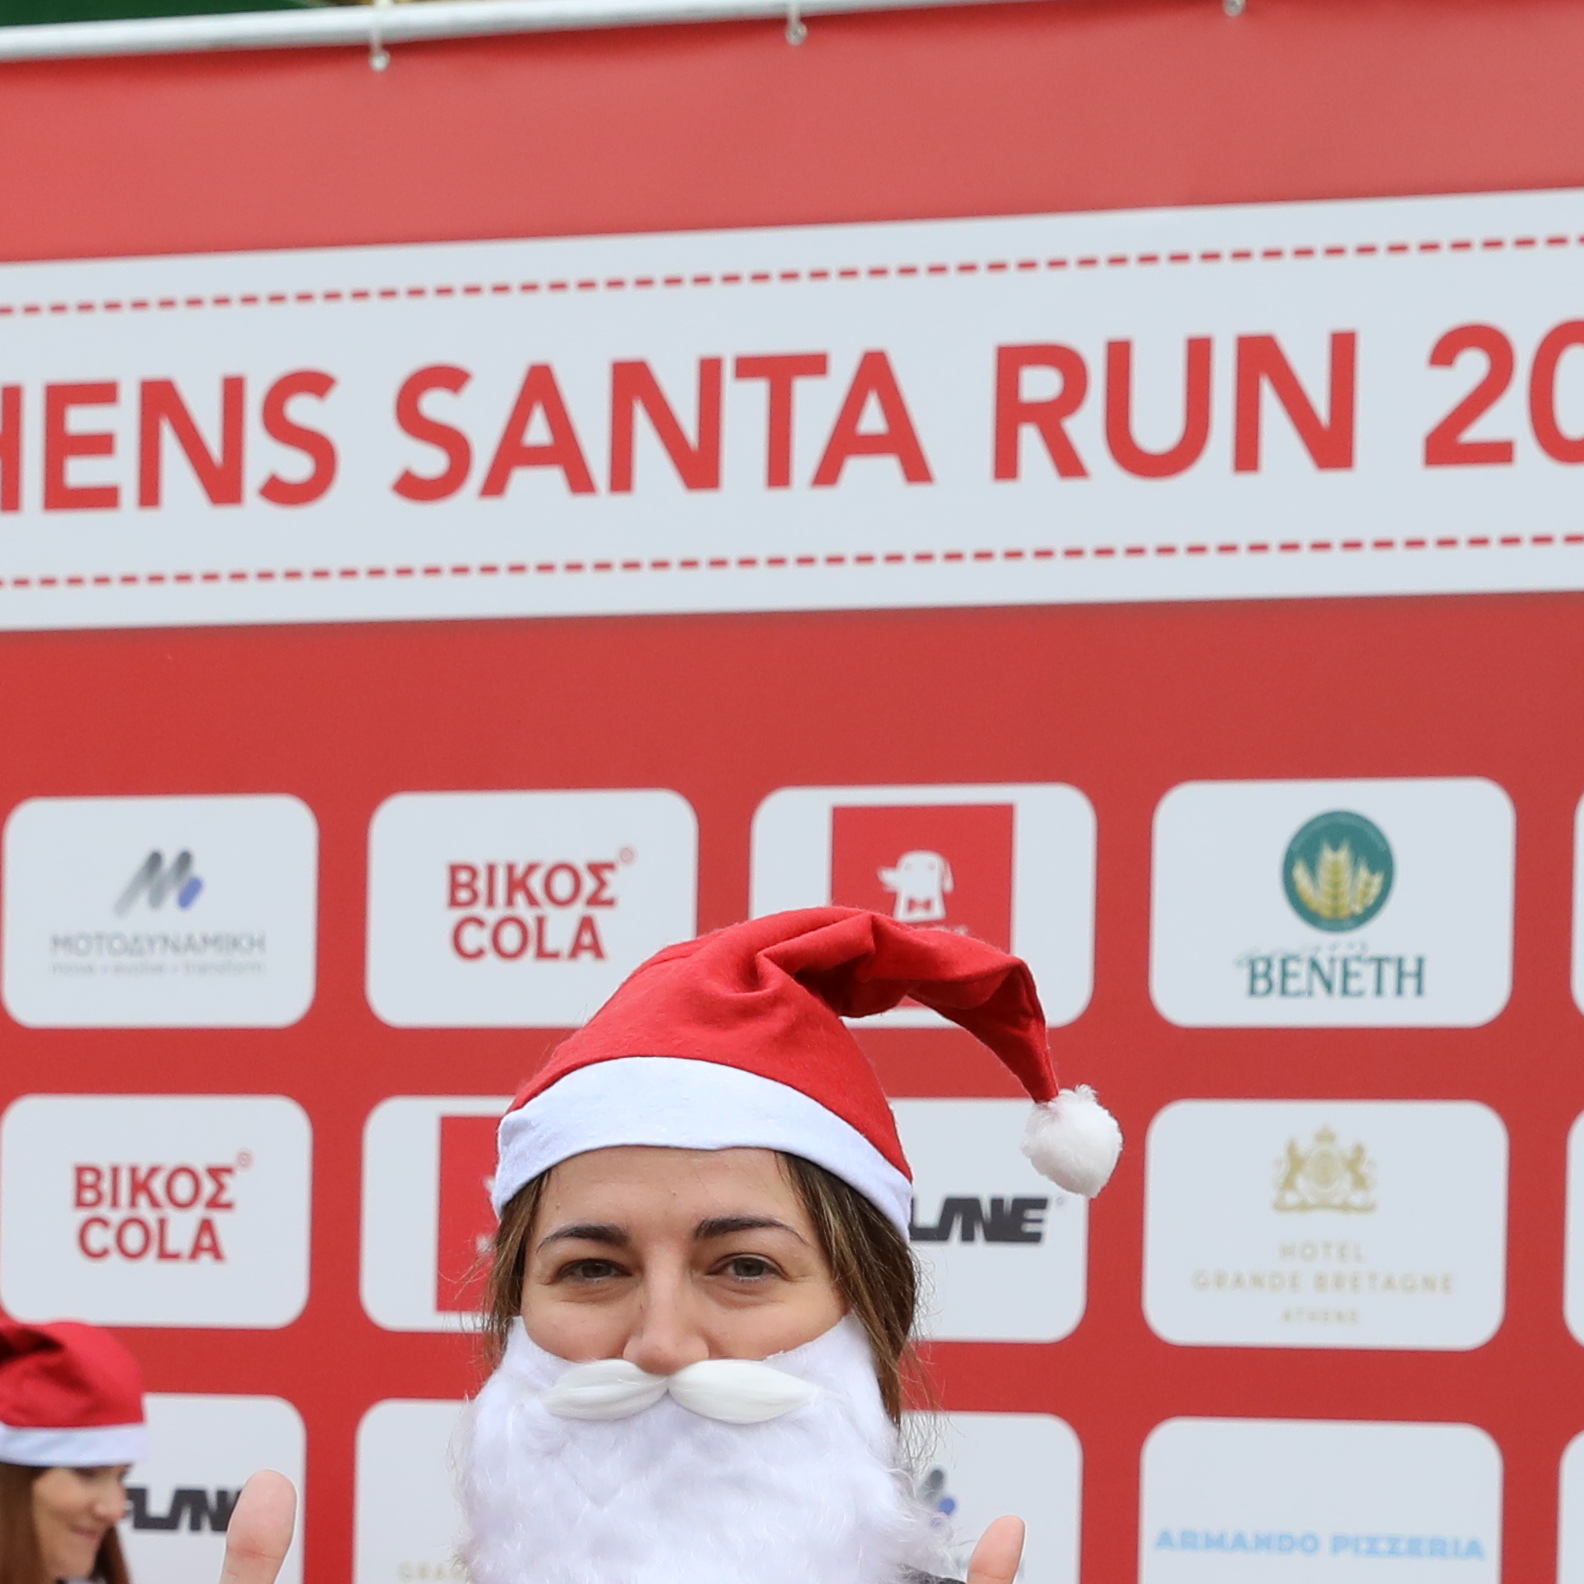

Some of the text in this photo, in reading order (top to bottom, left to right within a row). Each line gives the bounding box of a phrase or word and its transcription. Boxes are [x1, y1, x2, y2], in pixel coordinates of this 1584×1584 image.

[391, 349, 935, 504] SANTA
[993, 330, 1358, 483] RUN
[447, 861, 618, 910] ΒΙΚΟΣ
[452, 914, 607, 962] COLA
[1247, 953, 1427, 997] BENETH
[73, 1164, 235, 1210] ΒΙΚΟΣ
[77, 1216, 226, 1263] COLA
[908, 1197, 1048, 1243] LINE
[1278, 1240, 1364, 1263] HOTEL
[1191, 1268, 1454, 1296] GRANDE BRETAGNE
[1153, 1528, 1485, 1560] ARMANDO PIZZERIA
